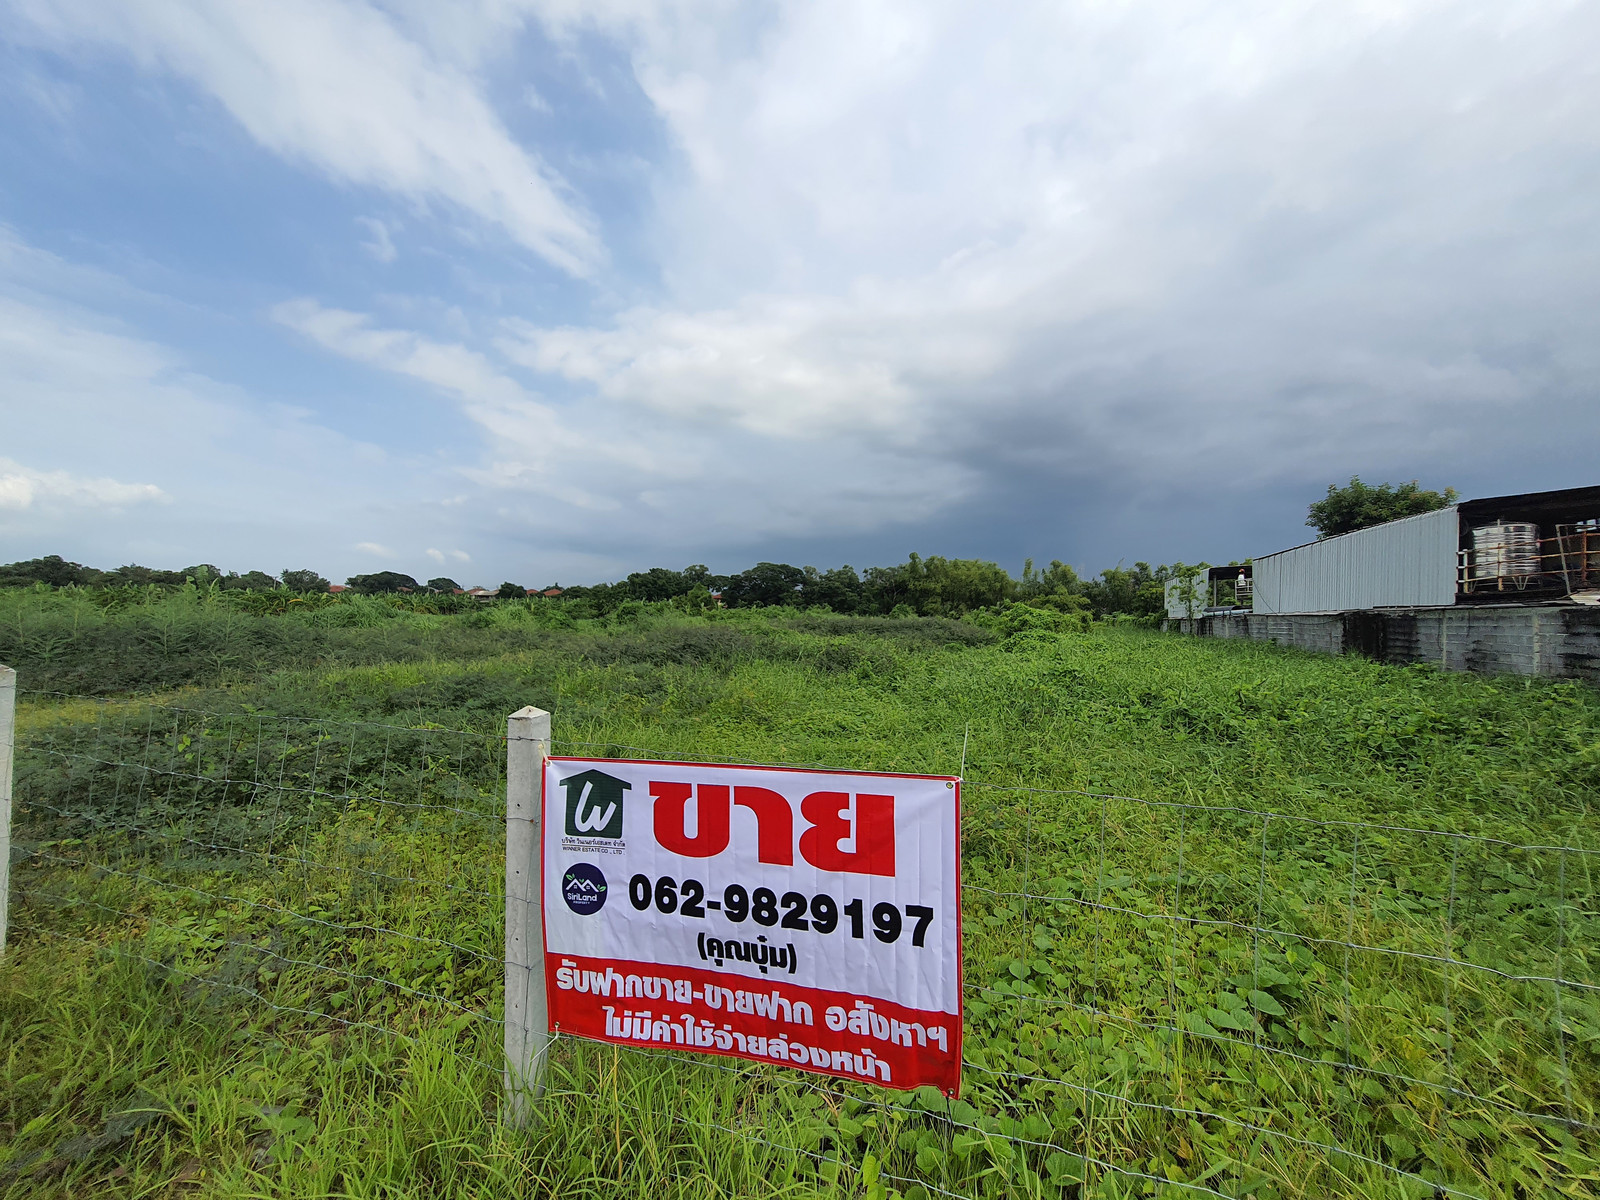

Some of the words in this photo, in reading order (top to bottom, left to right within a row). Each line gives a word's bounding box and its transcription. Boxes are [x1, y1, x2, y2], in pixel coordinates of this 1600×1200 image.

[648, 780, 896, 877] ขาย
[567, 893, 598, 902] SiriLand
[629, 873, 934, 948] 062-9829197
[696, 932, 798, 974] (คุณบุ๋ม)
[556, 958, 813, 1026] รับฝากขาย-ขายฝาก
[825, 1000, 948, 1053] อสังหาฯ
[602, 1005, 892, 1082] ไม่มีค่าใช้จ่ายล่วงหน้า
